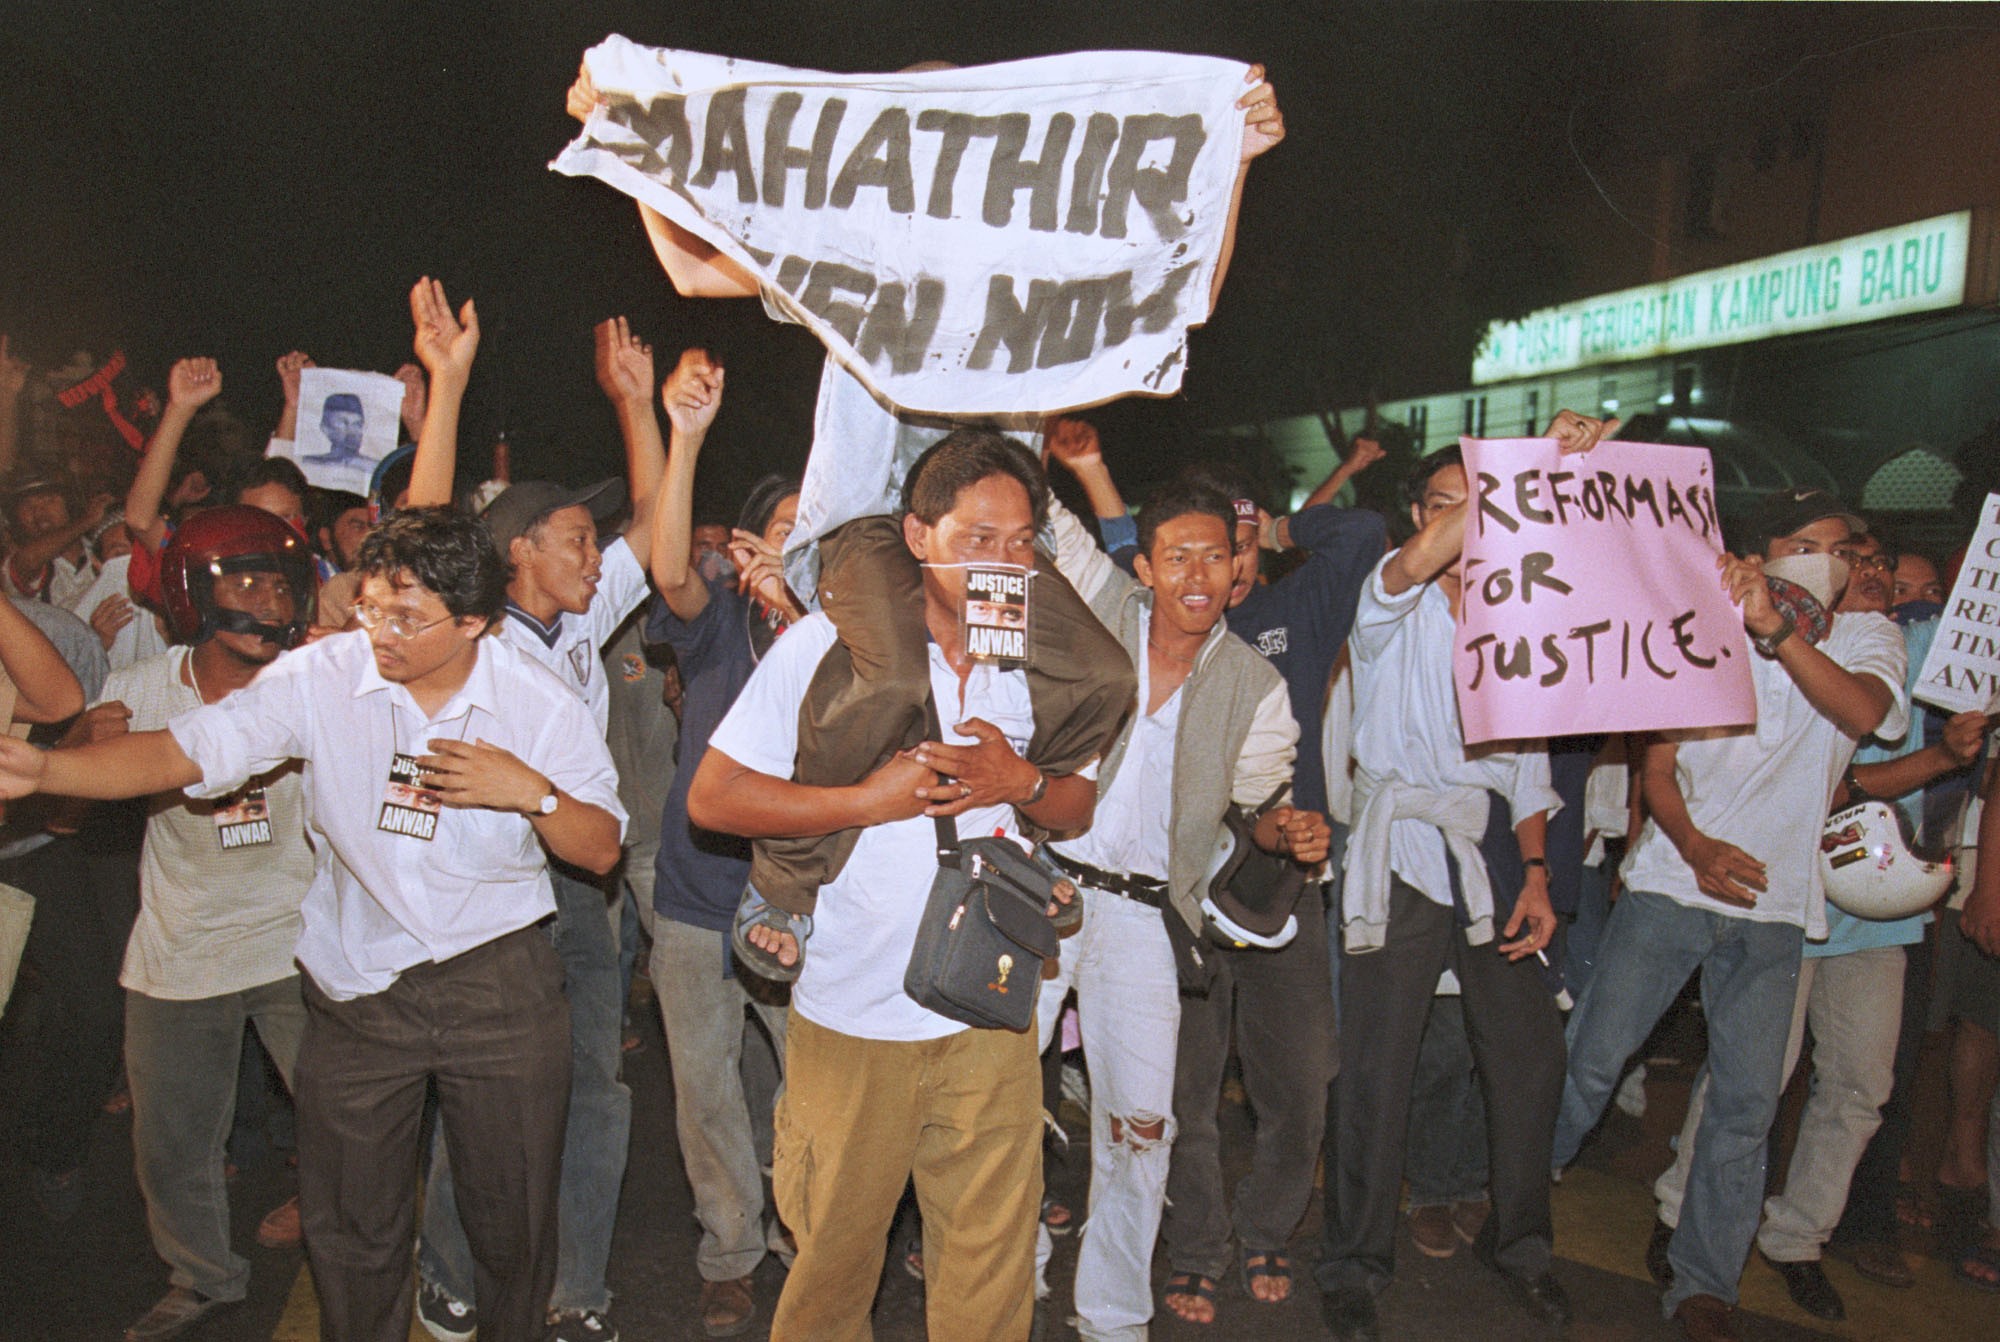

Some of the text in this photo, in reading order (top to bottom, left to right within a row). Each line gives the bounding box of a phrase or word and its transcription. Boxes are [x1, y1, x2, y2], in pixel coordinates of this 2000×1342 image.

[1514, 231, 1946, 366] PUSAT PERUBATAN KAMPUNG BARU
[967, 573, 1025, 596] JUSTICE
[990, 592, 1006, 603] FOR
[1463, 551, 1573, 625] FOR
[968, 626, 1024, 657] ANWAR
[221, 821, 271, 848] ANWAR
[380, 805, 436, 839] ANWAR
